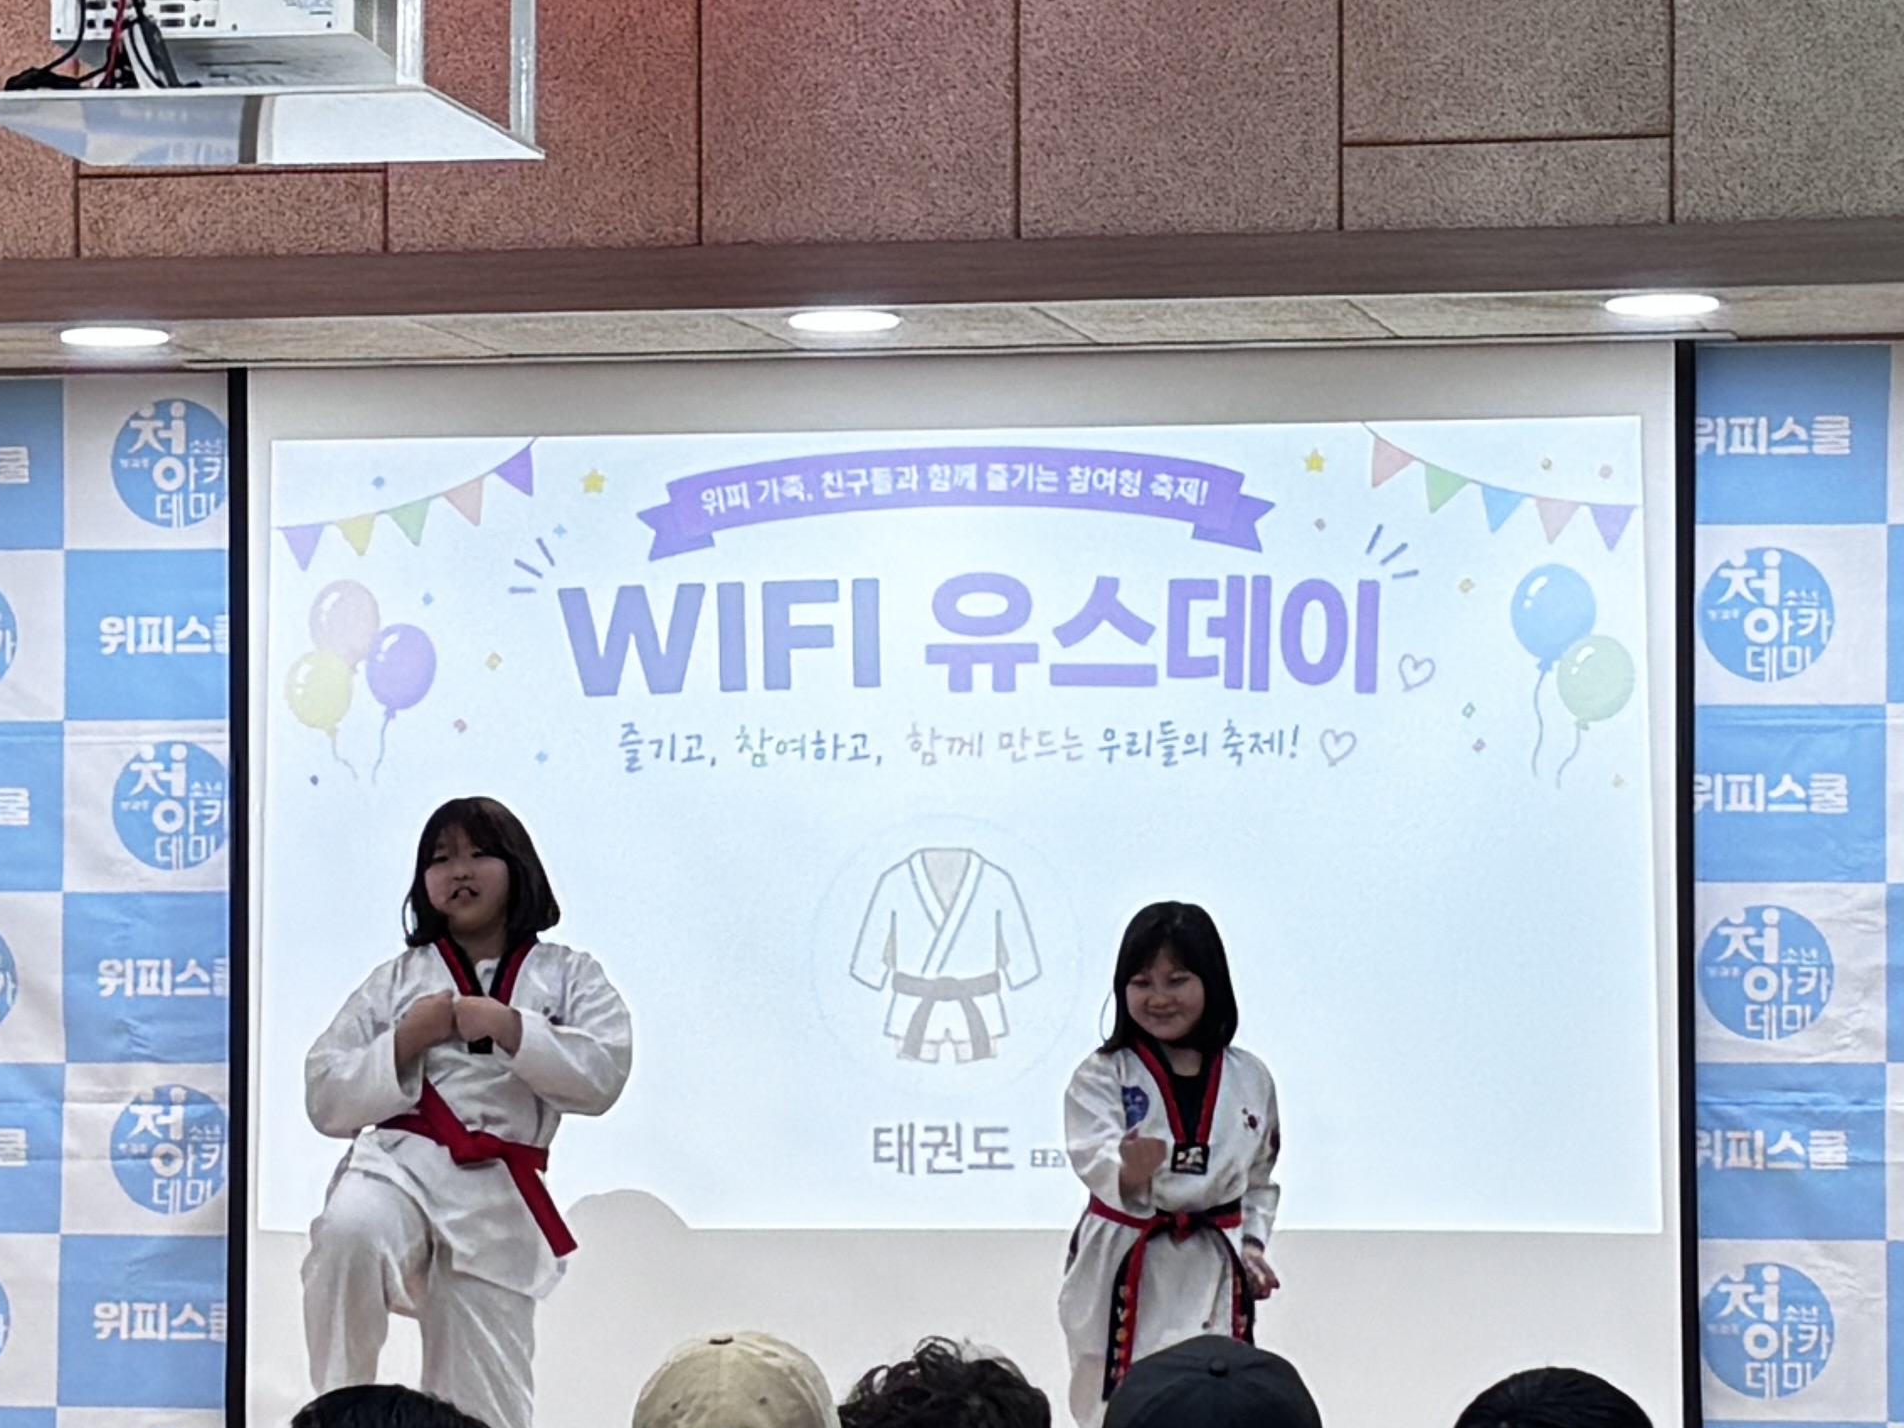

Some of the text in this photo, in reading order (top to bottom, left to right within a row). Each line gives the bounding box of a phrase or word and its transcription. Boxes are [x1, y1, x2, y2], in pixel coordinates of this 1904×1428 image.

[701, 488, 751, 517] 위피
[821, 466, 920, 500] 친구들과
[928, 463, 977, 493] 함께
[986, 463, 1060, 493] 즐기는
[1067, 465, 1142, 499] 참여형
[1150, 476, 1208, 506] 축제!
[557, 572, 1381, 697] WIFI 유스데이
[618, 720, 1301, 772] 즐기고, 참여하고, 함께 만드는 우리들의 축제!
[873, 1121, 1014, 1175] 태권도
